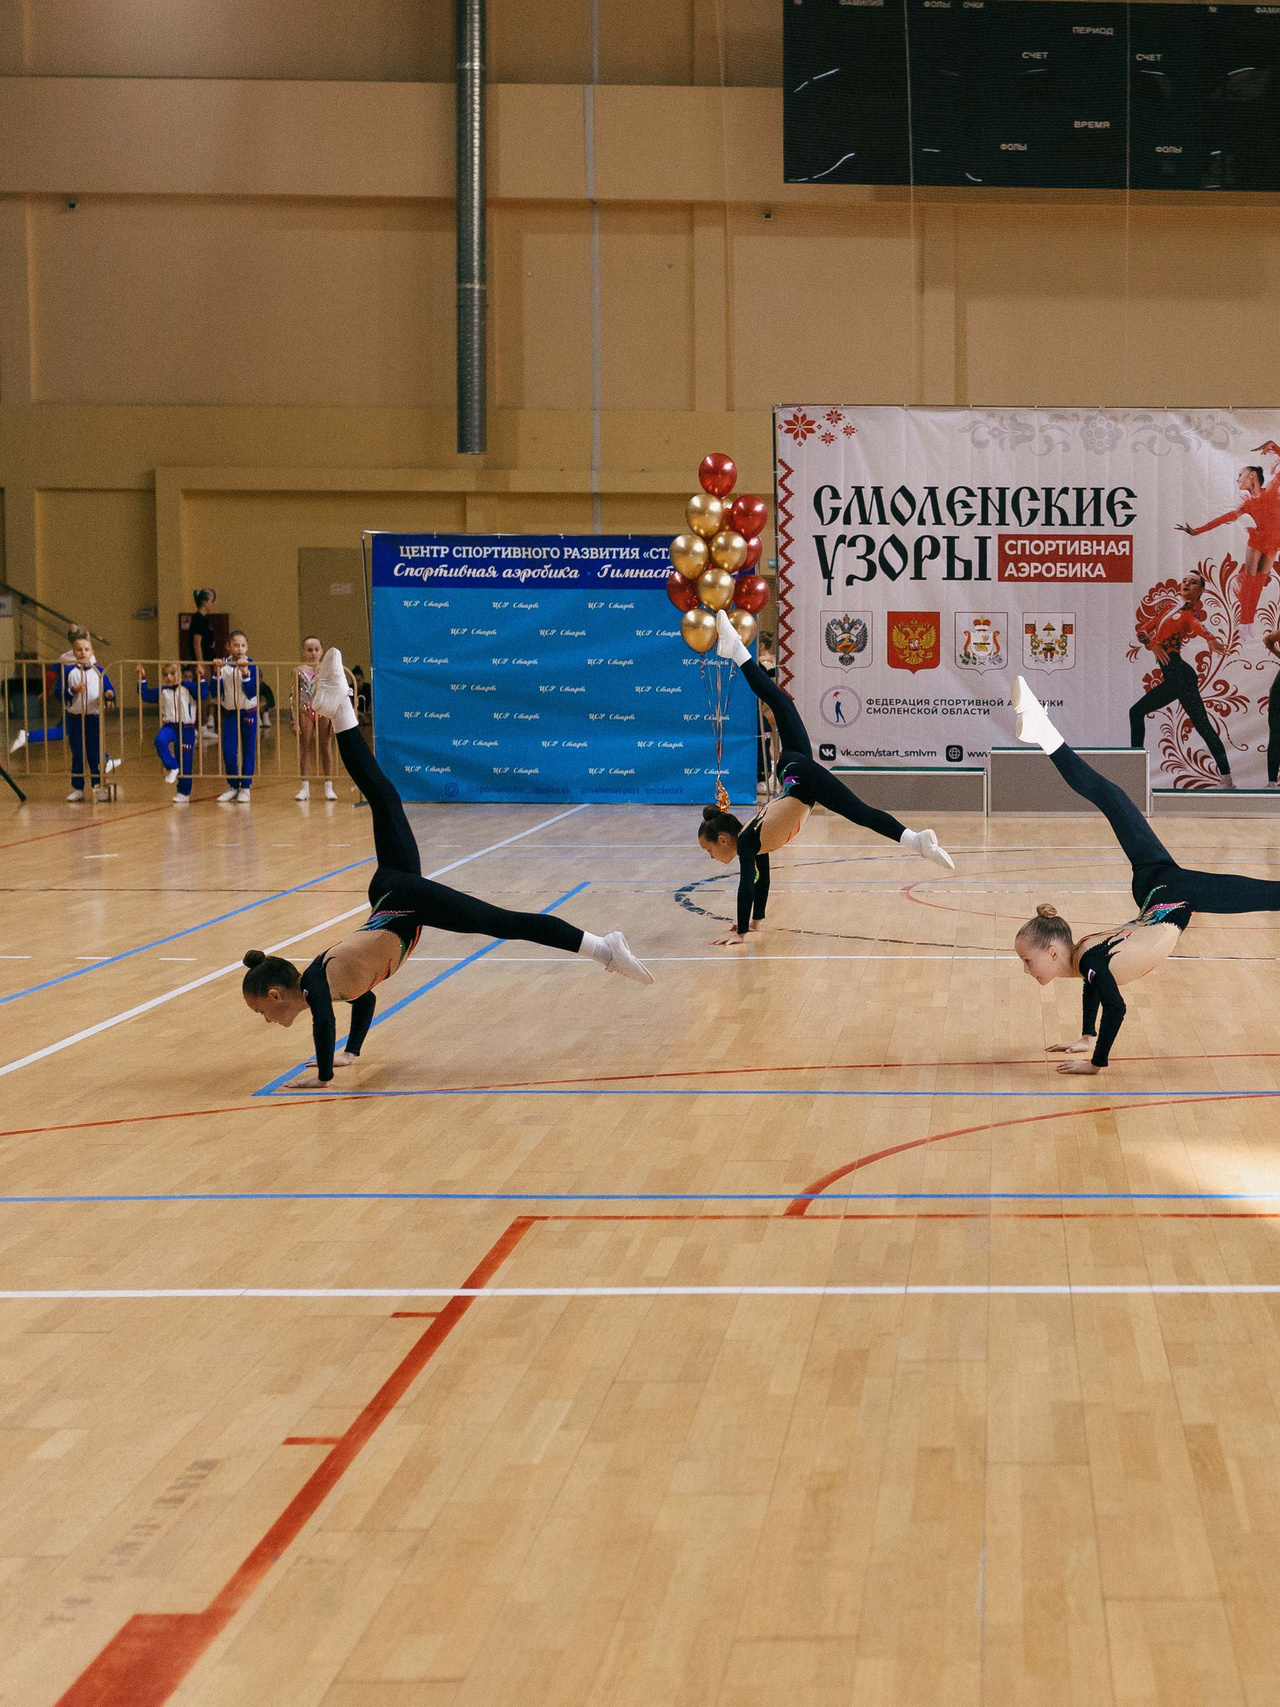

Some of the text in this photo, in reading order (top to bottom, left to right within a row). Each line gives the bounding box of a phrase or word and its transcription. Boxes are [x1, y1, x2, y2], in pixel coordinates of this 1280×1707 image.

[1072, 26, 1114, 36] ПЕРИОД
[1022, 51, 1048, 59] СЧЕТ
[1135, 53, 1162, 61] СЧЕТ
[1000, 143, 1027, 151] ФОЛЫ
[1155, 146, 1182, 154] ФОЛЫ
[813, 484, 1137, 527] СМОЛЕНСКИЕ
[400, 546, 670, 559] ЦЕНТР СПОРТИВНОГО РАЗВИТИЯ «СТ
[1004, 540, 1130, 556] СПОРТИВНАЯ
[812, 533, 992, 596] УЗОРЫ
[393, 563, 675, 583] Спортивная аэробика Гимнаст
[1004, 562, 1107, 578] АЭРОБИКА
[866, 698, 930, 707] ФЕДЕРАЦИЯ
[933, 698, 1003, 707] СПОРТИВНОЙ
[866, 707, 990, 716] СМОЛЕНСКОЙ ОБЛАСТИ
[840, 748, 937, 758] vk.com/start_smlvrn
